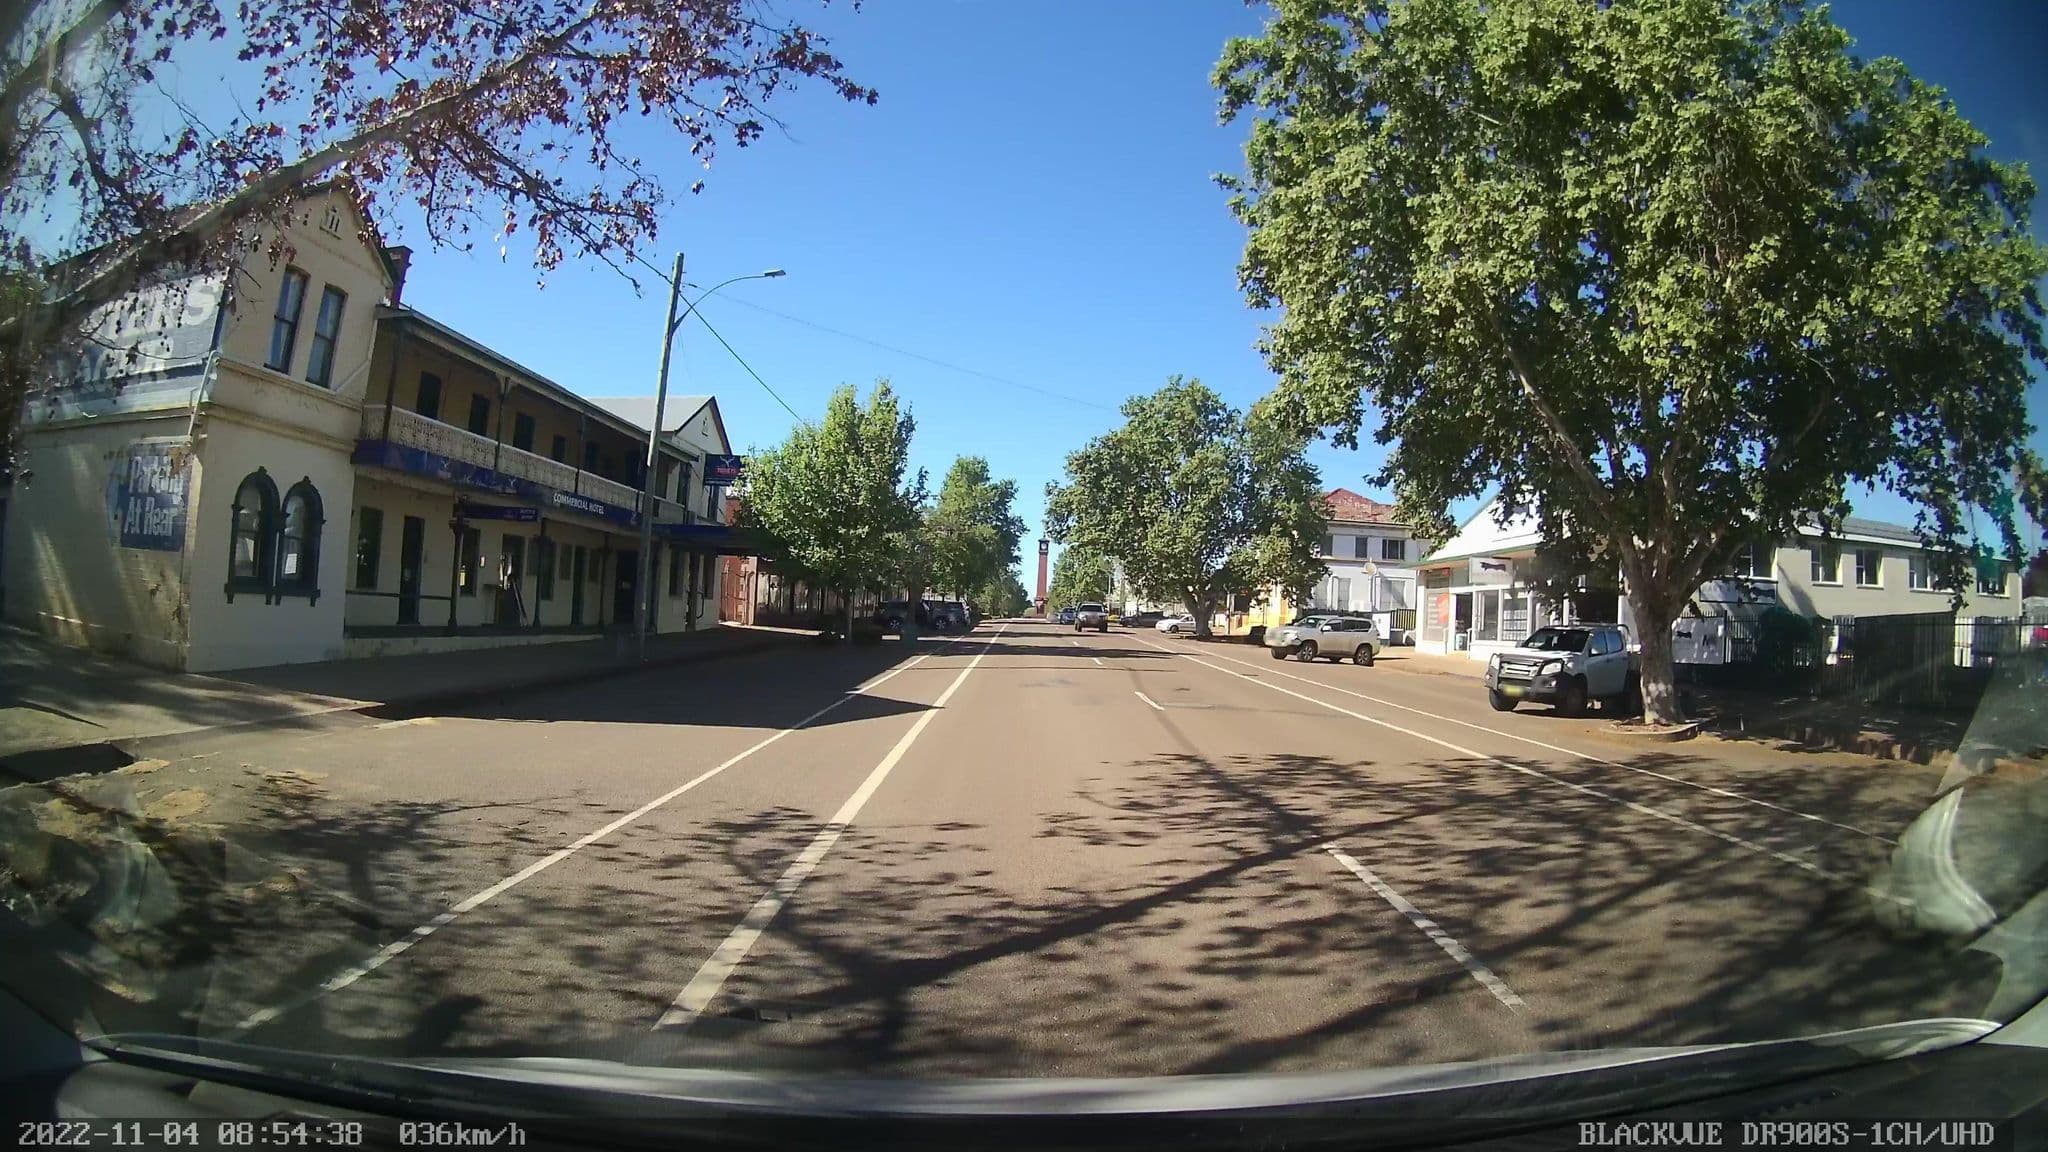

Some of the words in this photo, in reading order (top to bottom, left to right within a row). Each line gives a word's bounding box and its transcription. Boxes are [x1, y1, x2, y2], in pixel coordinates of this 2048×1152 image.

[128, 455, 184, 505] Parking
[123, 496, 142, 535] At
[142, 496, 179, 537] Rear
[552, 492, 589, 512] COMMERCIAL
[588, 501, 605, 516] HOTEL
